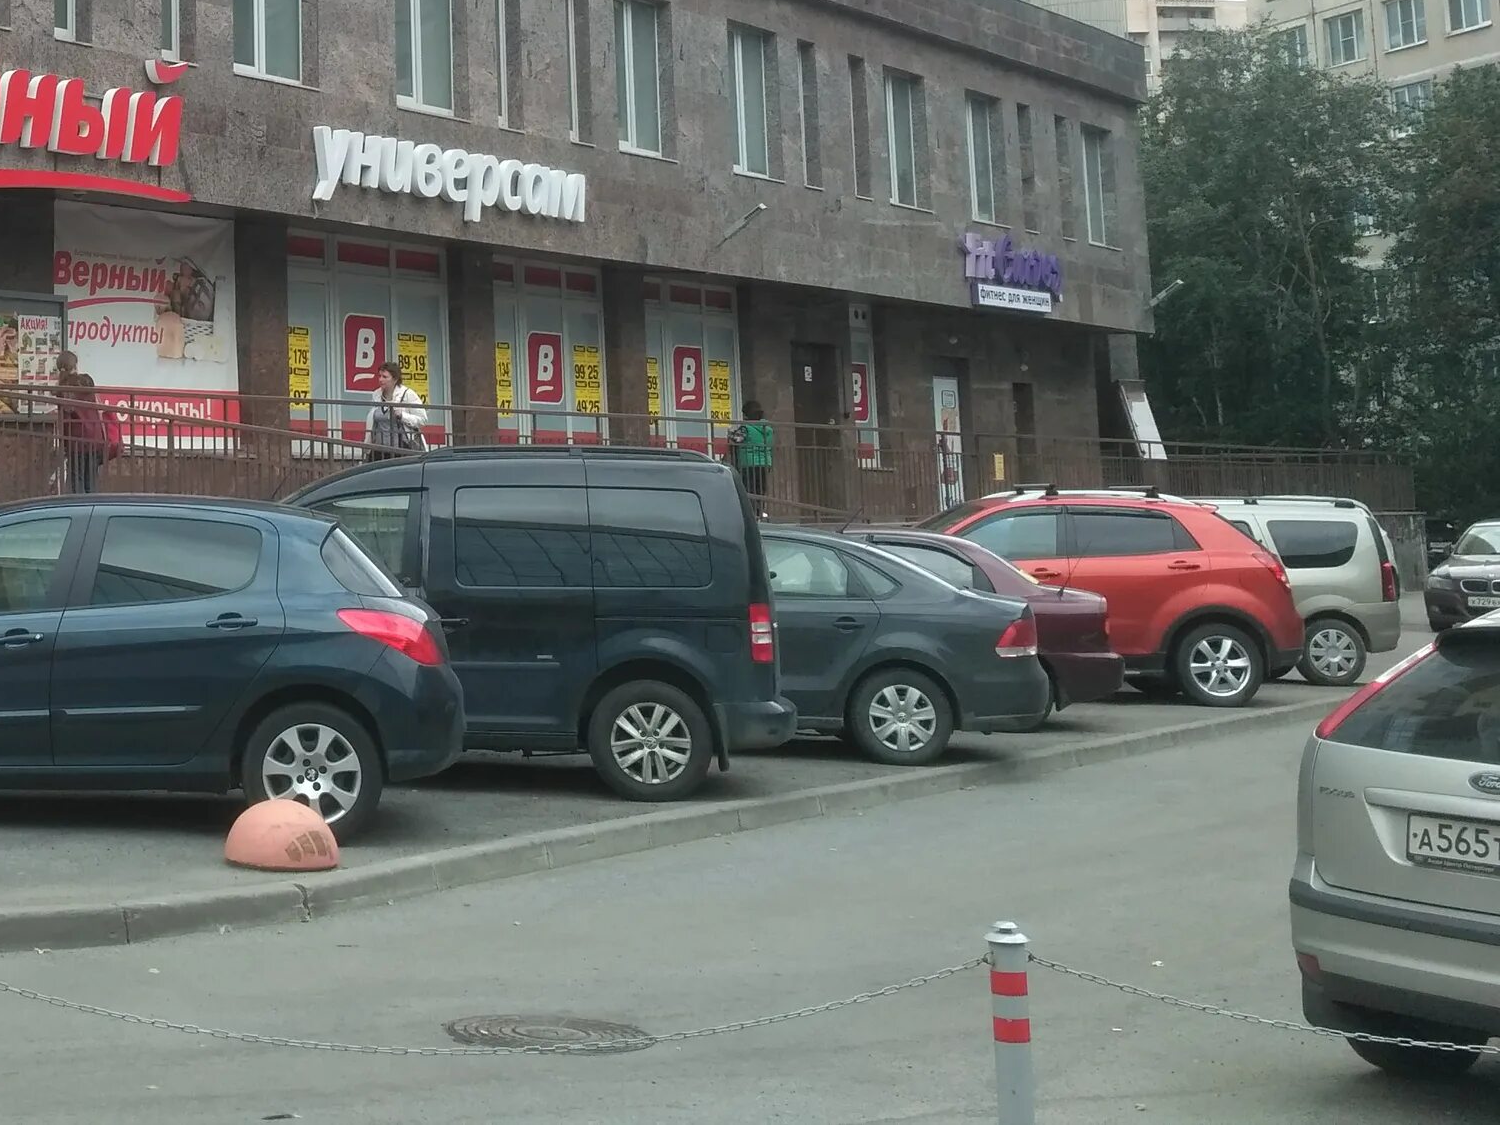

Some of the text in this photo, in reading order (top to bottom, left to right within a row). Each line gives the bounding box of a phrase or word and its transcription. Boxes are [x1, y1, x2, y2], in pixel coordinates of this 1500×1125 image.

[312, 125, 586, 223] универсам
[53, 250, 167, 296] Верный
[293, 347, 308, 365] 179
